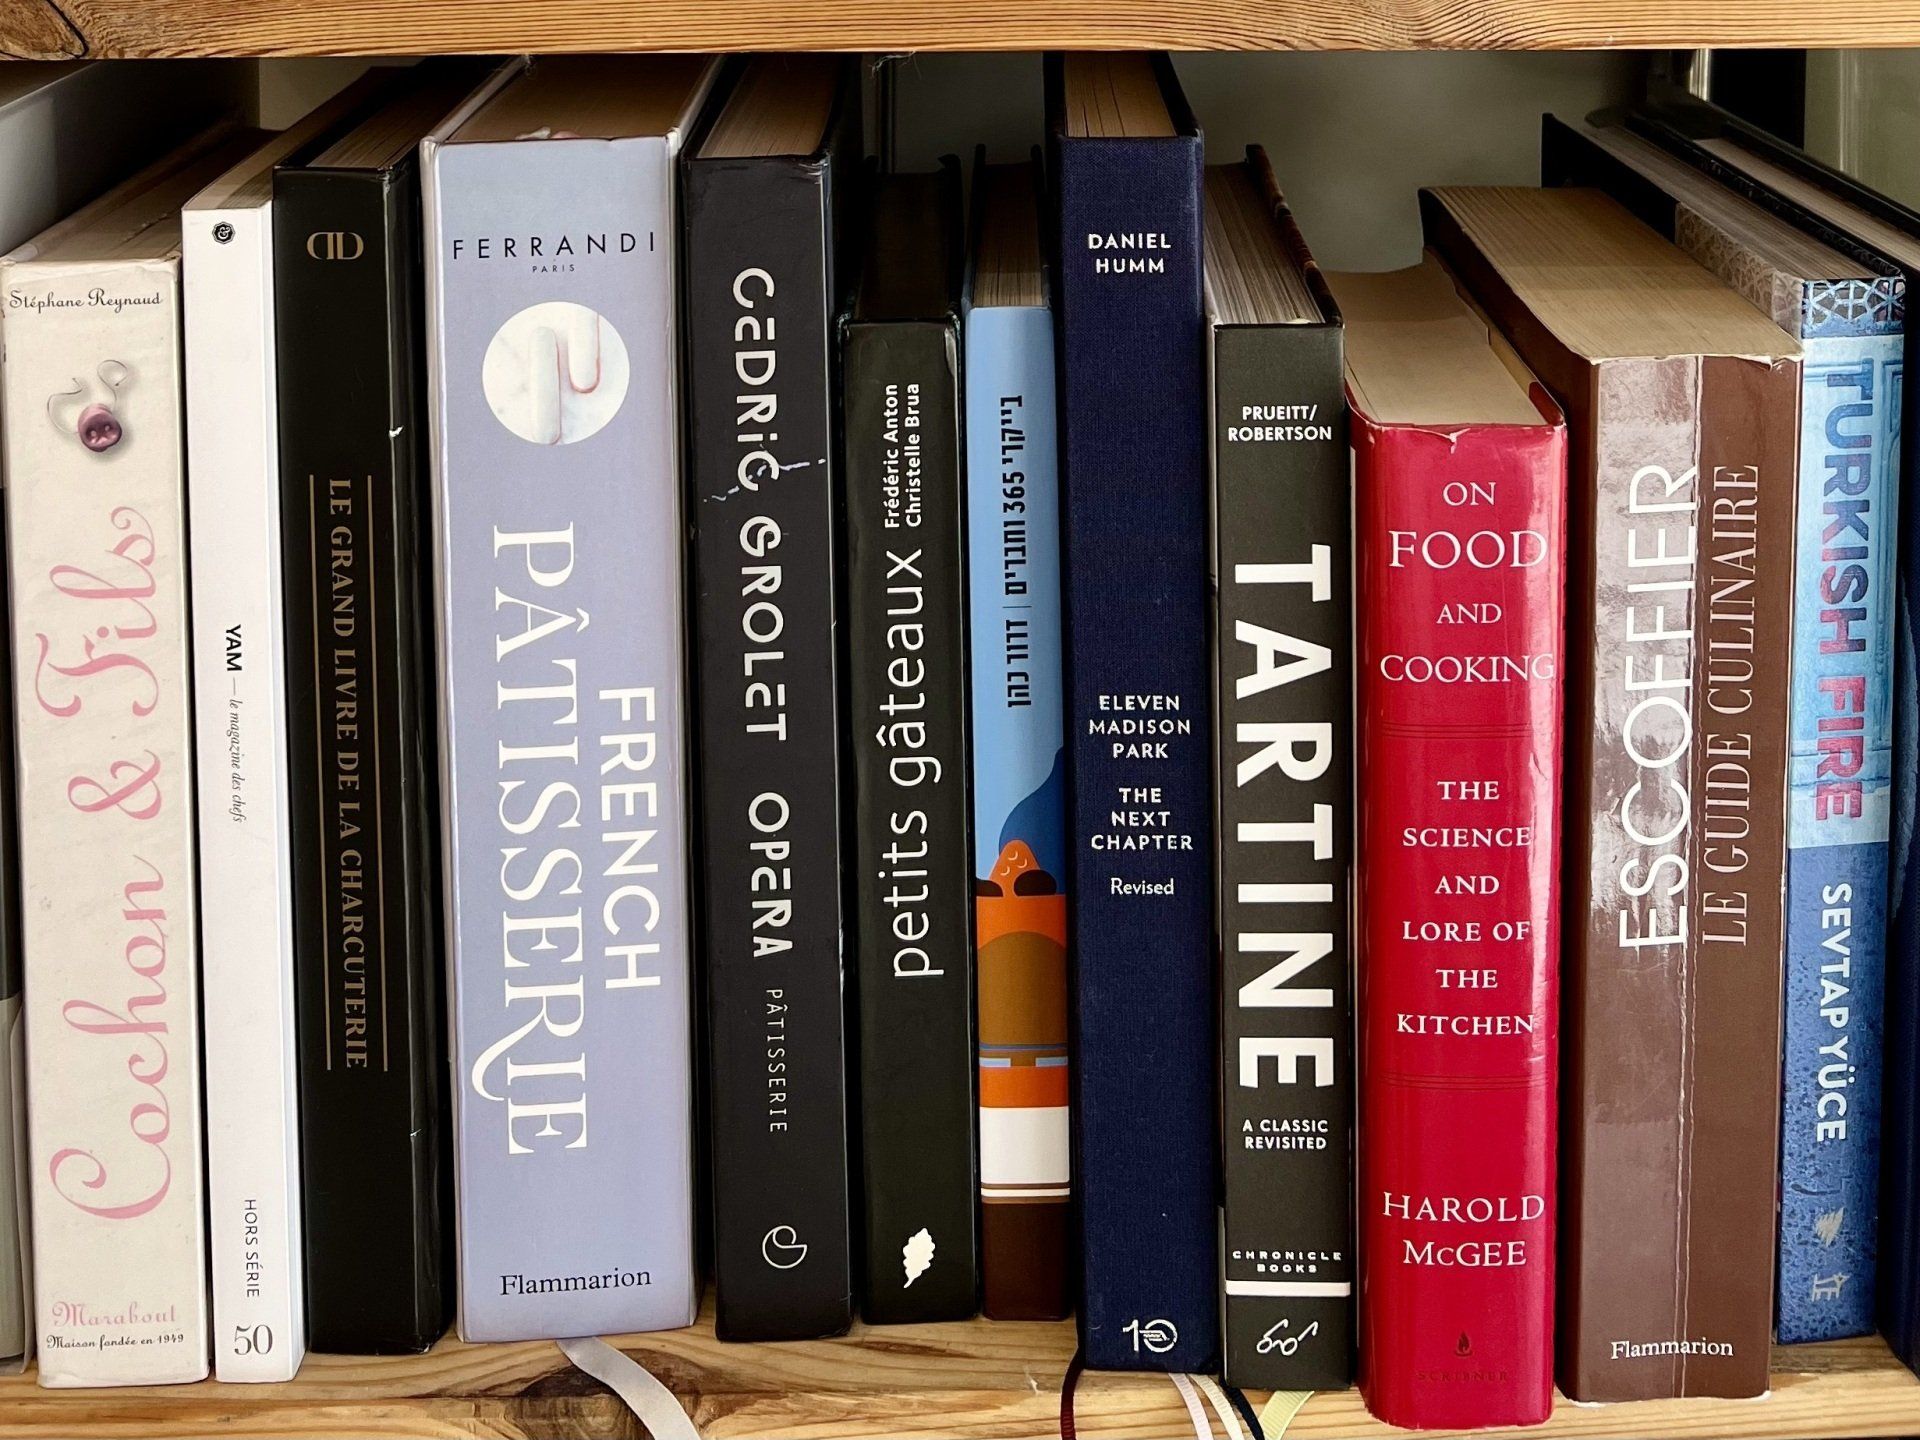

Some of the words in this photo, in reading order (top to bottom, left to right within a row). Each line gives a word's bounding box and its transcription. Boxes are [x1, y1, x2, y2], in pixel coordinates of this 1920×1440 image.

[453, 231, 655, 260] FERRANDI
[1087, 232, 1172, 250] DANIEL
[532, 263, 576, 273] PARIS
[1095, 257, 1165, 274] HUMM
[9, 289, 84, 313] Stéphane
[88, 288, 162, 313] Reynaud
[884, 384, 899, 443] Anton
[905, 383, 921, 428] Brua
[1242, 405, 1318, 422] PRUEITT/
[1228, 425, 1333, 442] ROBERTSON
[329, 479, 352, 516] LE
[884, 448, 900, 529] Frédéric
[905, 435, 922, 528] Christelle
[1003, 471, 1027, 514] 365
[1442, 482, 1496, 506] ON
[1818, 358, 1874, 655] TURKISH
[1003, 520, 1027, 596] וחברים
[1388, 530, 1548, 569] FOOD
[330, 524, 356, 638] GRAND
[1707, 464, 1759, 716] CULINAIRE
[34, 505, 160, 718] Fils
[739, 515, 787, 742] GROLET
[1436, 603, 1502, 624] AND
[226, 624, 242, 671] YAM
[1006, 619, 1028, 664] דרור
[876, 548, 942, 787] gâteaux
[1380, 654, 1555, 683] COOKING
[229, 699, 243, 709] le
[334, 648, 358, 741] LIVRE
[1007, 671, 1032, 708] כהן
[1099, 695, 1180, 711] ELEVEN
[1618, 464, 1697, 948] ESCOFFIER
[226, 711, 245, 769] magazine
[1089, 720, 1191, 735] MADISON
[1112, 743, 1168, 759] PARK
[1815, 675, 1866, 822] FIRE
[67, 748, 162, 822] &
[231, 773, 246, 790] des
[336, 751, 360, 791] DE
[228, 794, 247, 823] chefs
[1119, 788, 1162, 803] THE
[1438, 780, 1500, 800] THE
[1703, 732, 1753, 873] GUIDE
[338, 801, 361, 840] LA
[1111, 812, 1171, 827] NEXT
[1235, 544, 1334, 1089] TARTINE
[471, 521, 590, 1155] PÂTISSERIE
[599, 686, 661, 990] FRENCH
[1091, 835, 1194, 850] CHAPTER
[1402, 827, 1532, 847] SCIENCE
[748, 791, 793, 960] OPERA
[878, 808, 945, 978] petits
[1110, 877, 1175, 896] Revised
[1434, 875, 1500, 894] AND
[1402, 921, 1481, 942] LORE
[1492, 922, 1532, 942] OF
[1702, 890, 1748, 946] LE
[339, 849, 368, 1069] CHARCUTERIE
[1820, 882, 1852, 1028] SEVTAP
[1436, 969, 1498, 989] THE
[50, 855, 171, 1220] Cochon
[1397, 1013, 1535, 1036] KITCHEN
[765, 988, 788, 1133] PÂTISSERIE
[1817, 1036, 1856, 1142] YÜCE
[1243, 1118, 1253, 1132] A
[1260, 1119, 1328, 1133] CLASSIC
[1245, 1136, 1327, 1150] REVISITED
[244, 1199, 258, 1245] HORS
[1382, 1192, 1546, 1223] HAROLD
[1232, 1250, 1343, 1260] CHRONICLE
[1256, 1264, 1319, 1273] BOOKS
[1403, 1240, 1528, 1267] McGEE
[245, 1252, 262, 1298] SÉRIE
[500, 1267, 652, 1295] Flammarion
[52, 1301, 176, 1328] Marabout
[46, 1334, 95, 1349] Maison
[100, 1334, 136, 1350] fondée
[157, 1333, 184, 1344] 1949
[233, 1324, 274, 1356] 50
[1611, 1338, 1735, 1360] Flammarion
